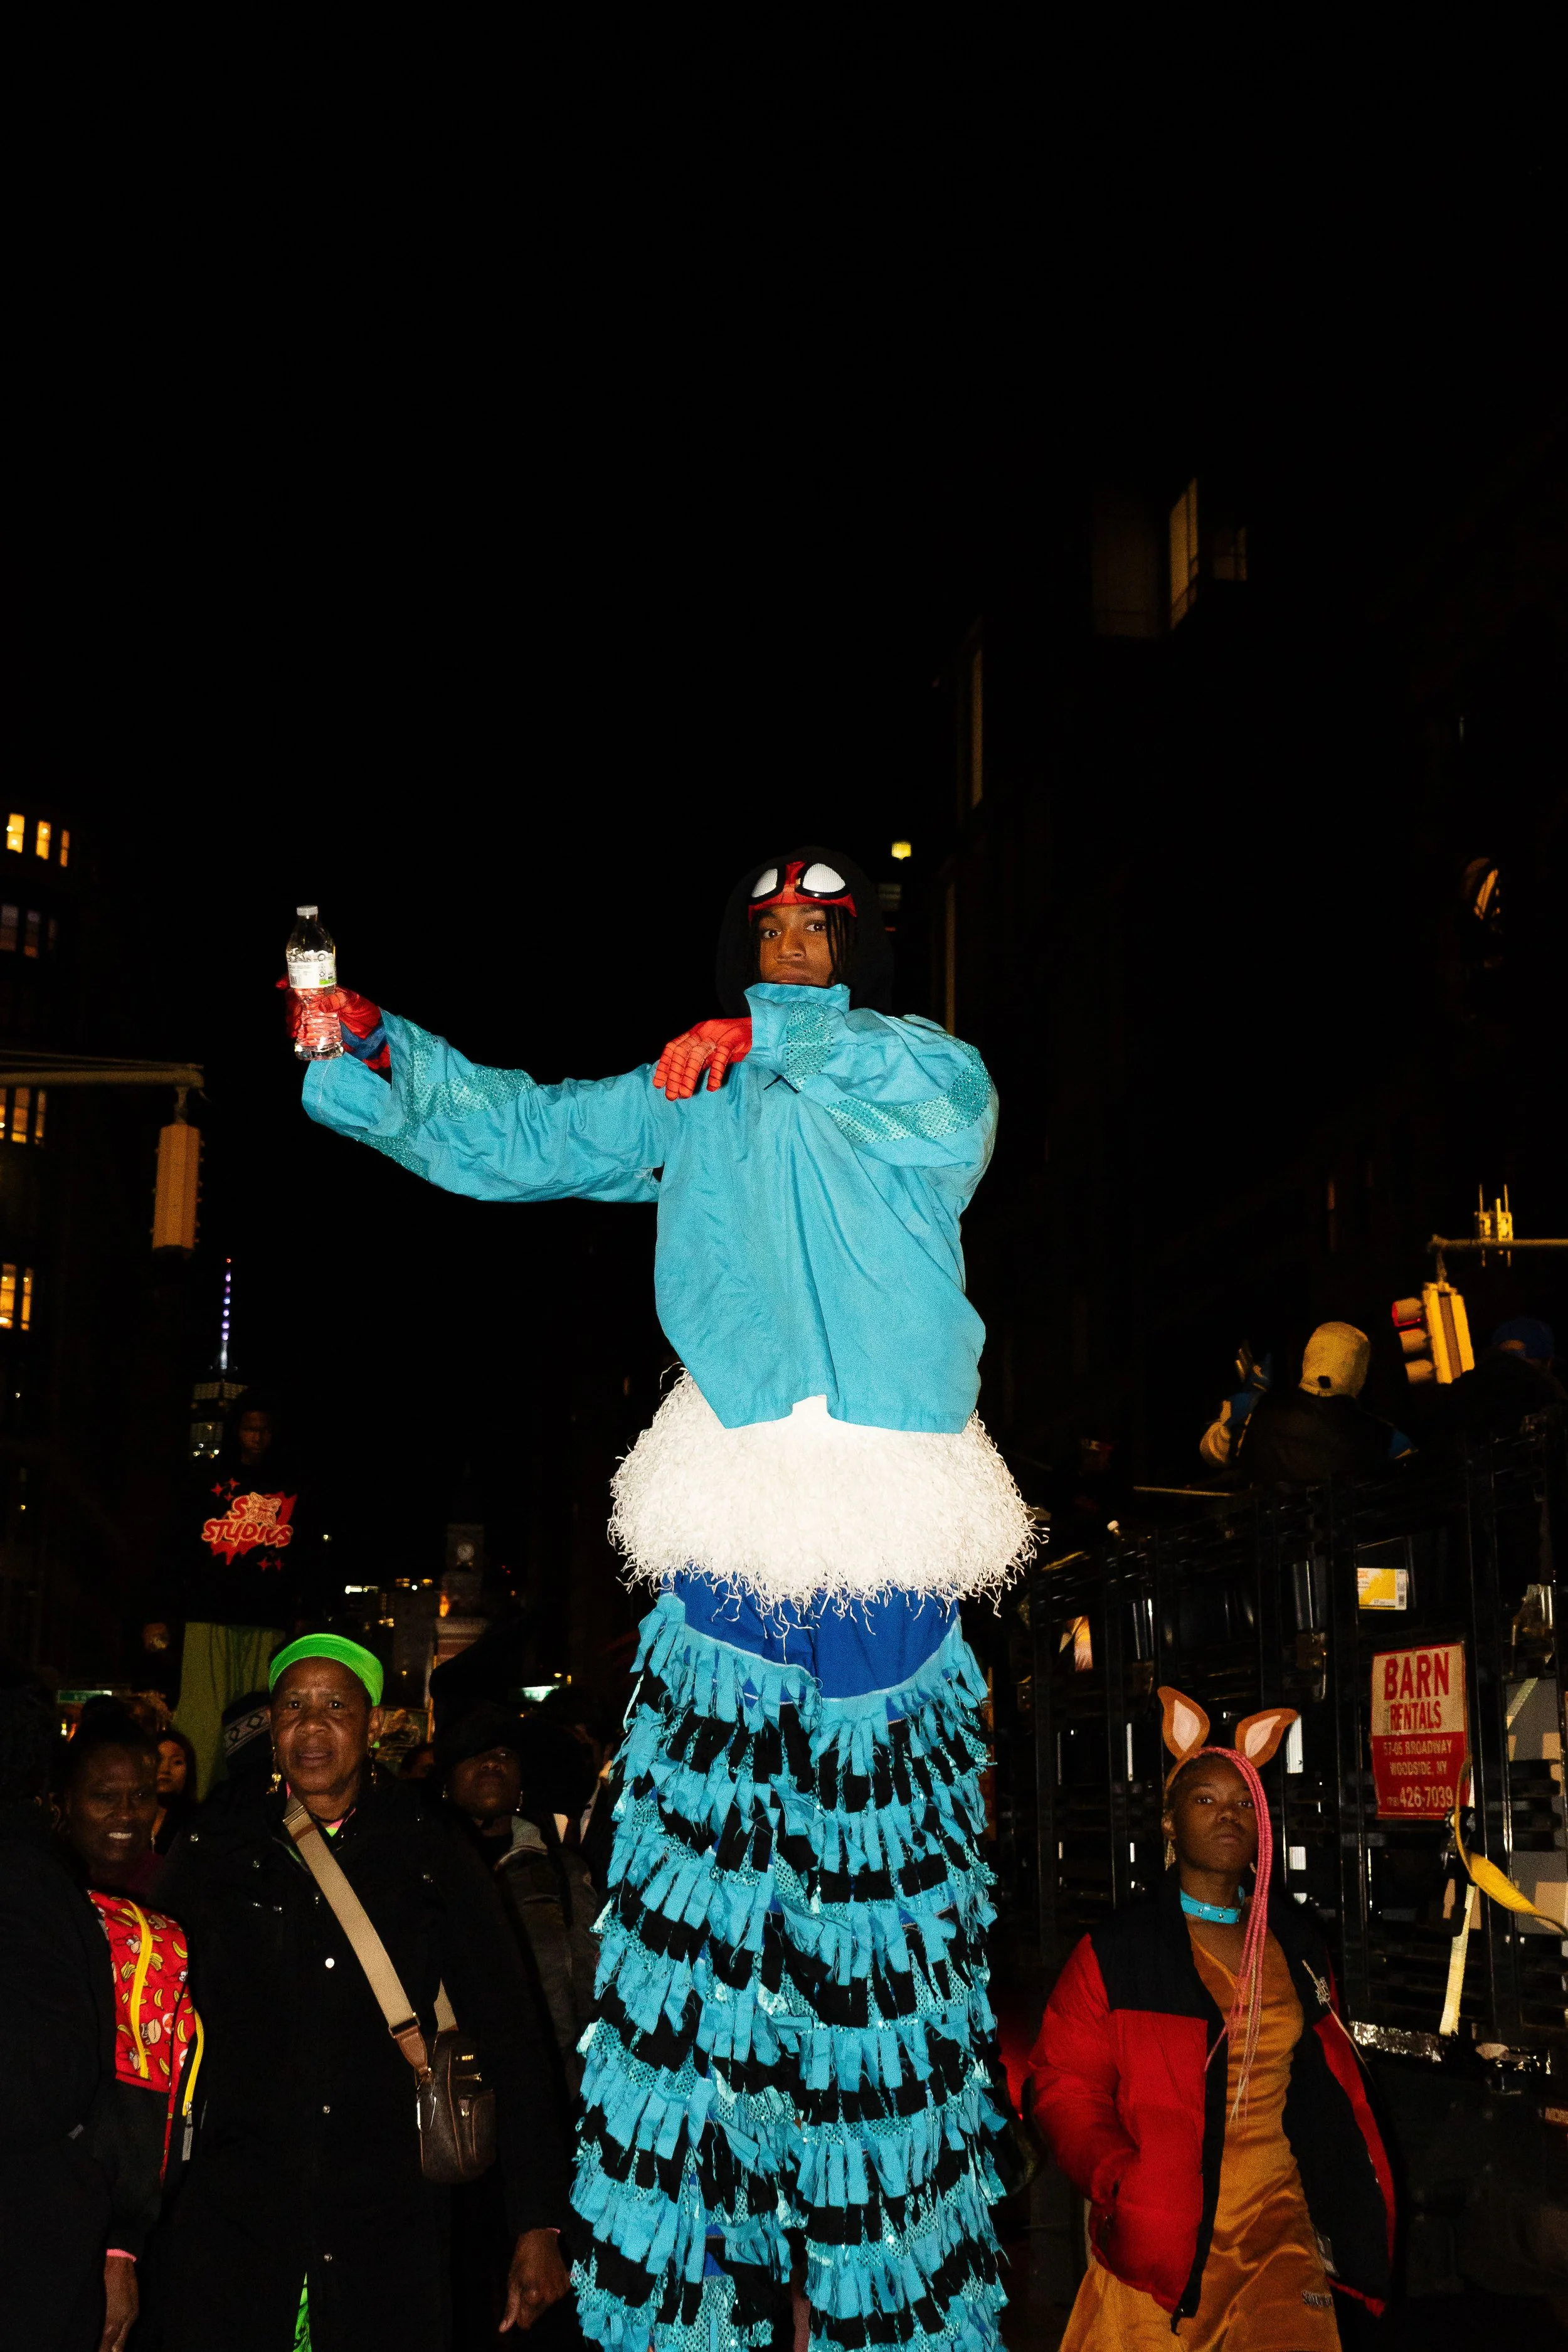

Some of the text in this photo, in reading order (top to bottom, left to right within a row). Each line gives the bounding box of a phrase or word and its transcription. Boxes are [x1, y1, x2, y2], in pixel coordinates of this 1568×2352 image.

[1384, 1651, 1449, 1700] BARN
[1389, 1700, 1442, 1731] RENTALS
[1405, 1739, 1453, 1755] BROADWAY
[1436, 1760, 1448, 1774] NY
